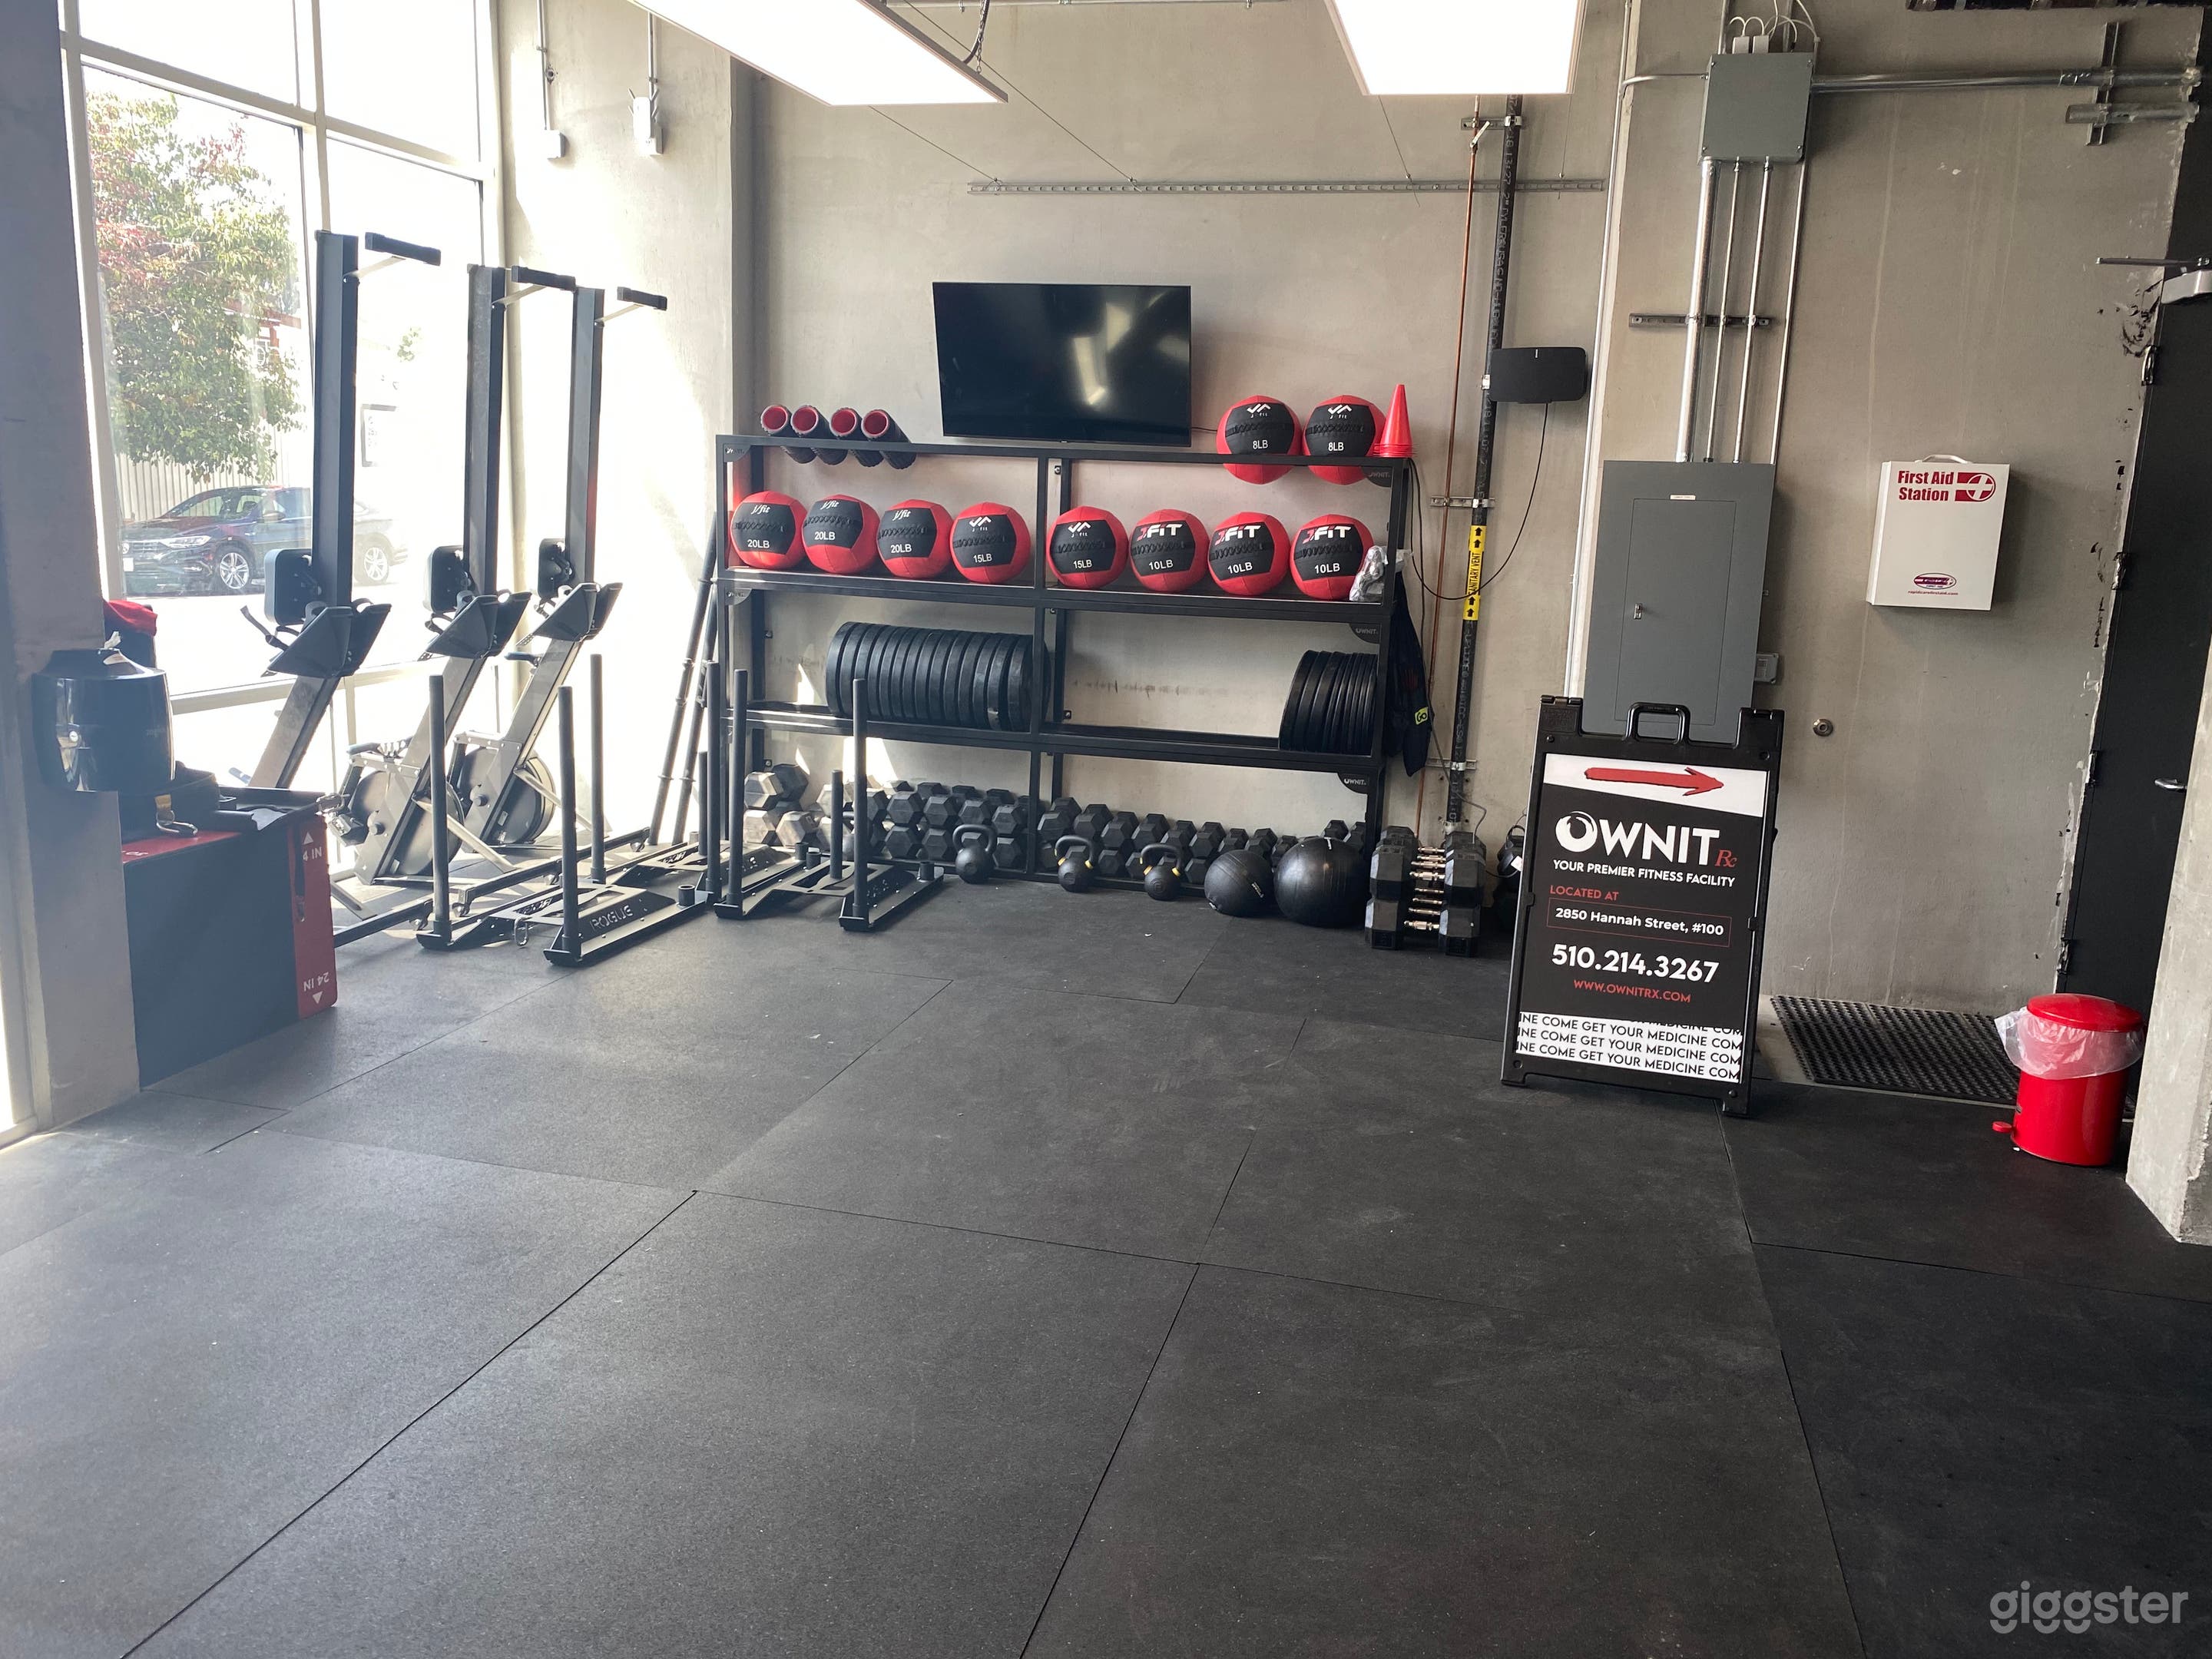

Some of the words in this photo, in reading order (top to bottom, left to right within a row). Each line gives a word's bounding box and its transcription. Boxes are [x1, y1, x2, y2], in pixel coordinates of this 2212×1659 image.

[1253, 439, 1268, 449] 8LB
[1328, 442, 1344, 452] 8LB
[1897, 470, 1929, 484] First
[1931, 472, 1955, 485] Aid
[1899, 487, 1949, 502] Station
[747, 539, 770, 548] 20LB
[814, 531, 836, 541] 20LB
[891, 544, 912, 553] 20LB
[973, 553, 992, 563] 15LB
[1073, 559, 1092, 568] 15LB
[1148, 559, 1174, 570] 10LB
[1471, 552, 1482, 566] VENT
[1227, 562, 1253, 574] 10LB
[1314, 562, 1340, 574] 10LB
[1555, 810, 1720, 866] OWNIT
[312, 846, 322, 859] IN
[1553, 859, 1584, 873] YOUR
[1587, 863, 1635, 877] PREMIER
[1637, 868, 1684, 882] FITNESS
[1686, 873, 1736, 887] FACILITY
[1549, 885, 1601, 899] LOCATED
[1604, 891, 1619, 901] AT
[1555, 908, 1588, 921] 2850
[1590, 911, 1642, 927] Hannah
[1645, 917, 1688, 934] Street,
[1691, 923, 1724, 935] #100
[1551, 943, 1720, 983] 510.214.3267
[303, 977, 314, 992] IN
[316, 971, 329, 986] 24
[1573, 979, 1691, 1003] WWW.OWNITRX.COM
[1542, 1015, 1578, 1029] COME
[1582, 1022, 1607, 1033] GET
[1610, 1025, 1644, 1038] YOUR
[1647, 1029, 1707, 1046] MEDICINE
[1711, 1038, 1742, 1051] COM
[1541, 1030, 1577, 1044] COME
[1581, 1035, 1605, 1048] GET
[1608, 1038, 1642, 1052] YOUR
[1647, 1044, 1706, 1061] MEDICINE
[1710, 1052, 1740, 1065] COM
[1539, 1045, 1576, 1058] COME
[1579, 1049, 1604, 1061] GET
[1608, 1052, 1641, 1067] YOUR
[1645, 1058, 1705, 1075] MEDICINE
[1709, 1067, 1740, 1080] COM
